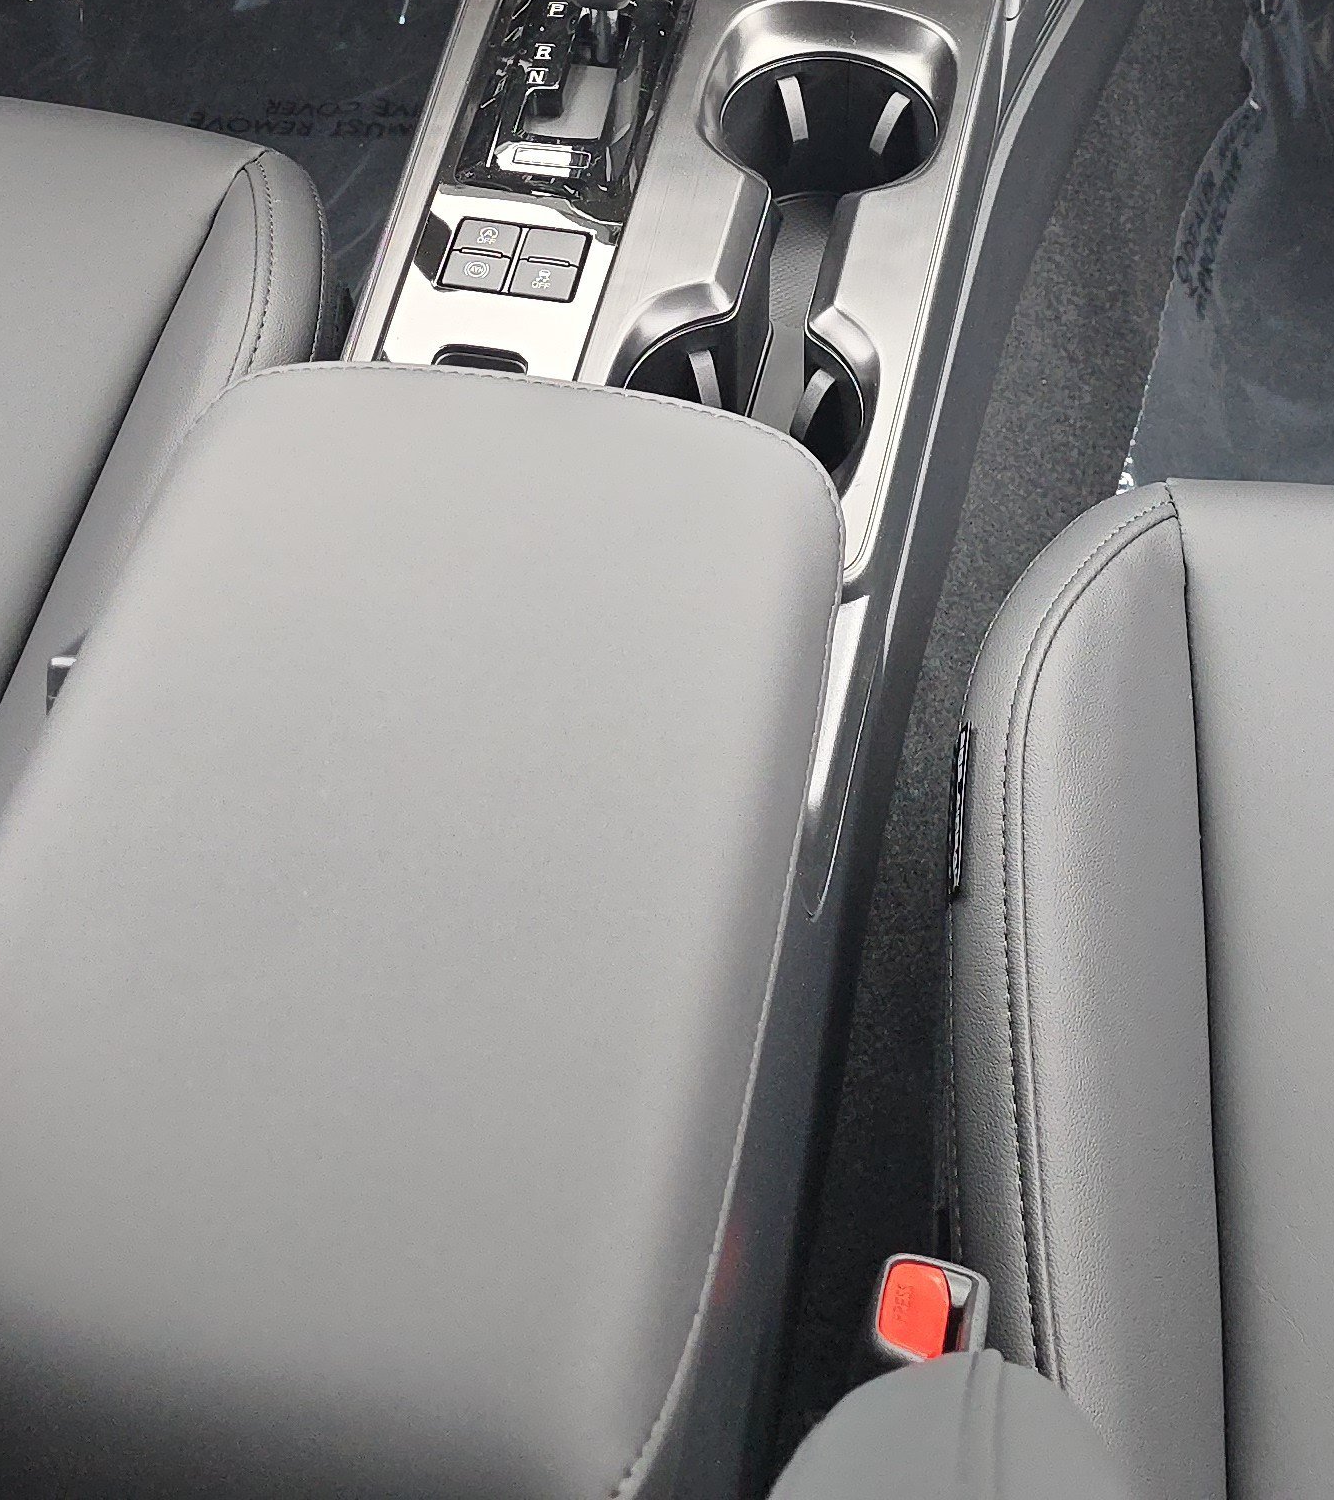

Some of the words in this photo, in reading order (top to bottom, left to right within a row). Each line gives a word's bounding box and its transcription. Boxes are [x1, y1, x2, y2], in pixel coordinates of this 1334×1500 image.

[548, 3, 565, 17] P
[534, 45, 552, 60] R
[527, 70, 546, 84] N
[476, 236, 498, 245] OFF
[531, 281, 553, 290] OFF
